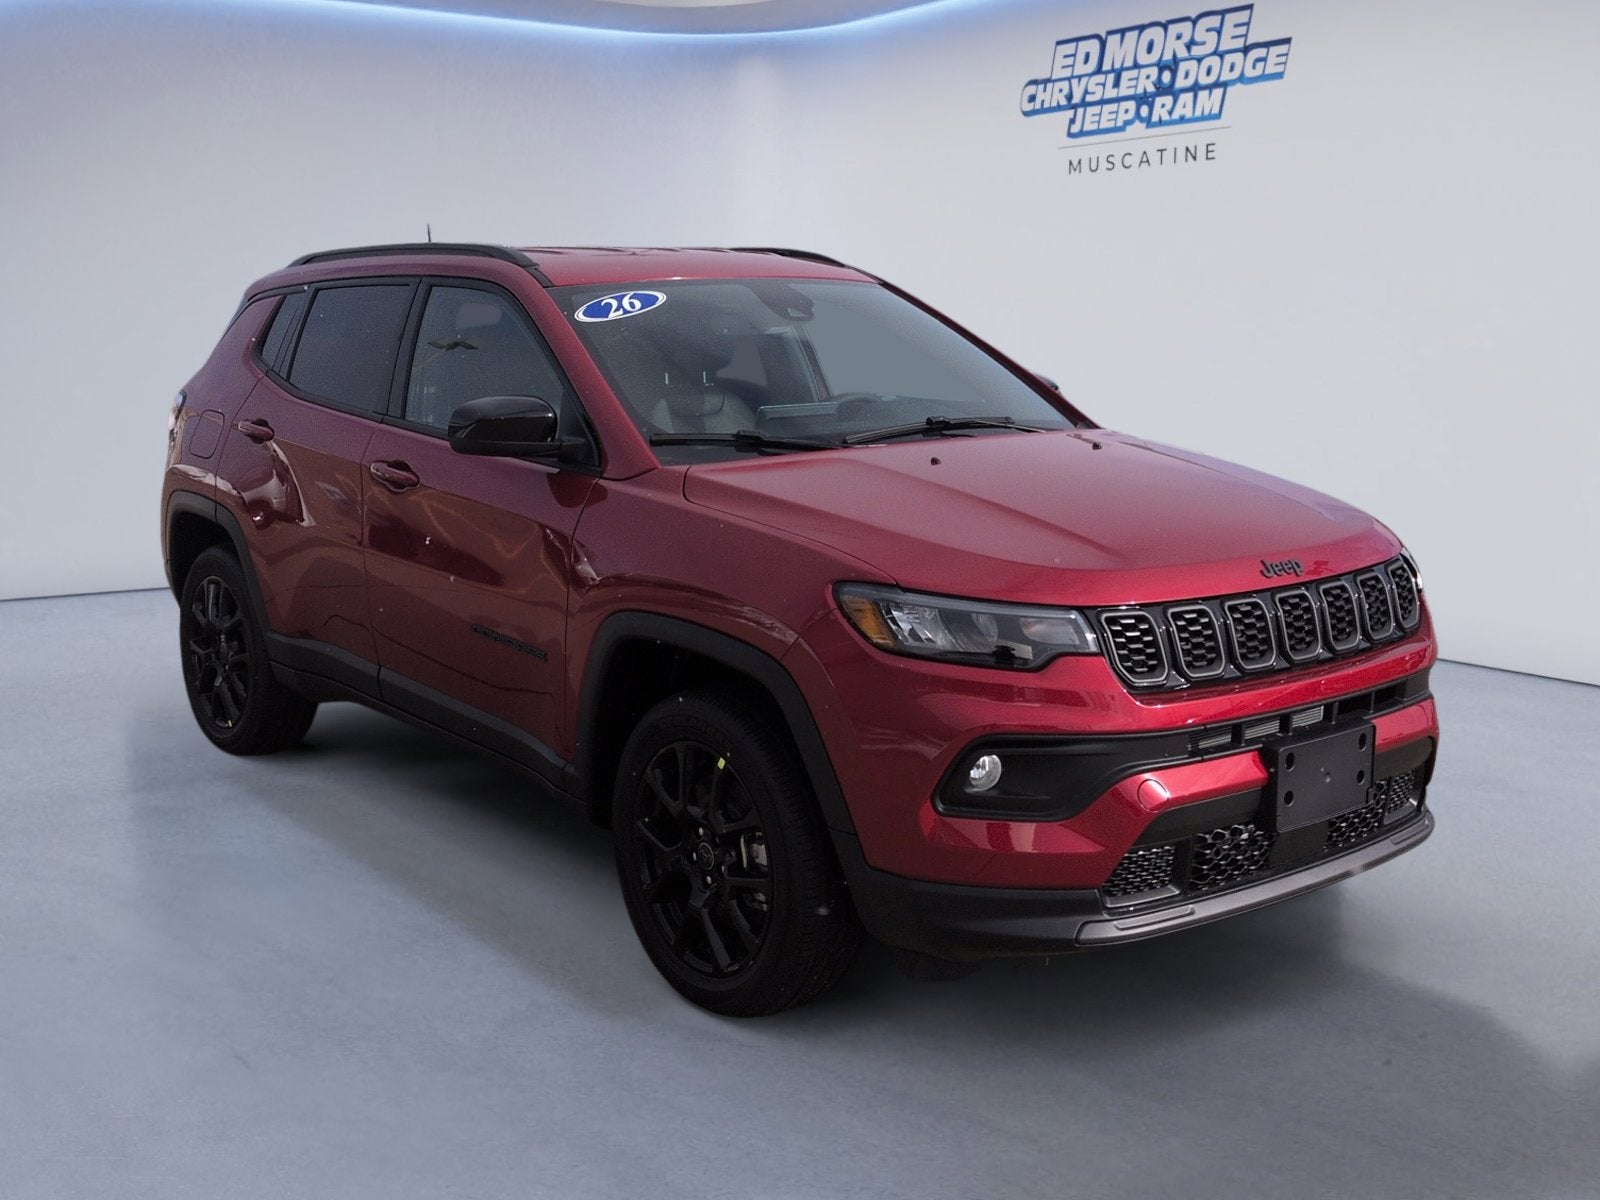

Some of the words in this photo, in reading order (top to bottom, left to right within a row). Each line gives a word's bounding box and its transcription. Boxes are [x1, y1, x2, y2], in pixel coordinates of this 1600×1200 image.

[1051, 36, 1102, 80] ED
[1102, 5, 1254, 72] MORSE
[1020, 66, 1159, 115] CHRYSLER
[1174, 40, 1292, 90] DODGE
[1068, 100, 1137, 136] JEEP
[1150, 87, 1226, 125] RAM
[1068, 143, 1217, 175] MUSCATINE
[601, 292, 642, 319] 26
[1260, 559, 1304, 579] Jeep
